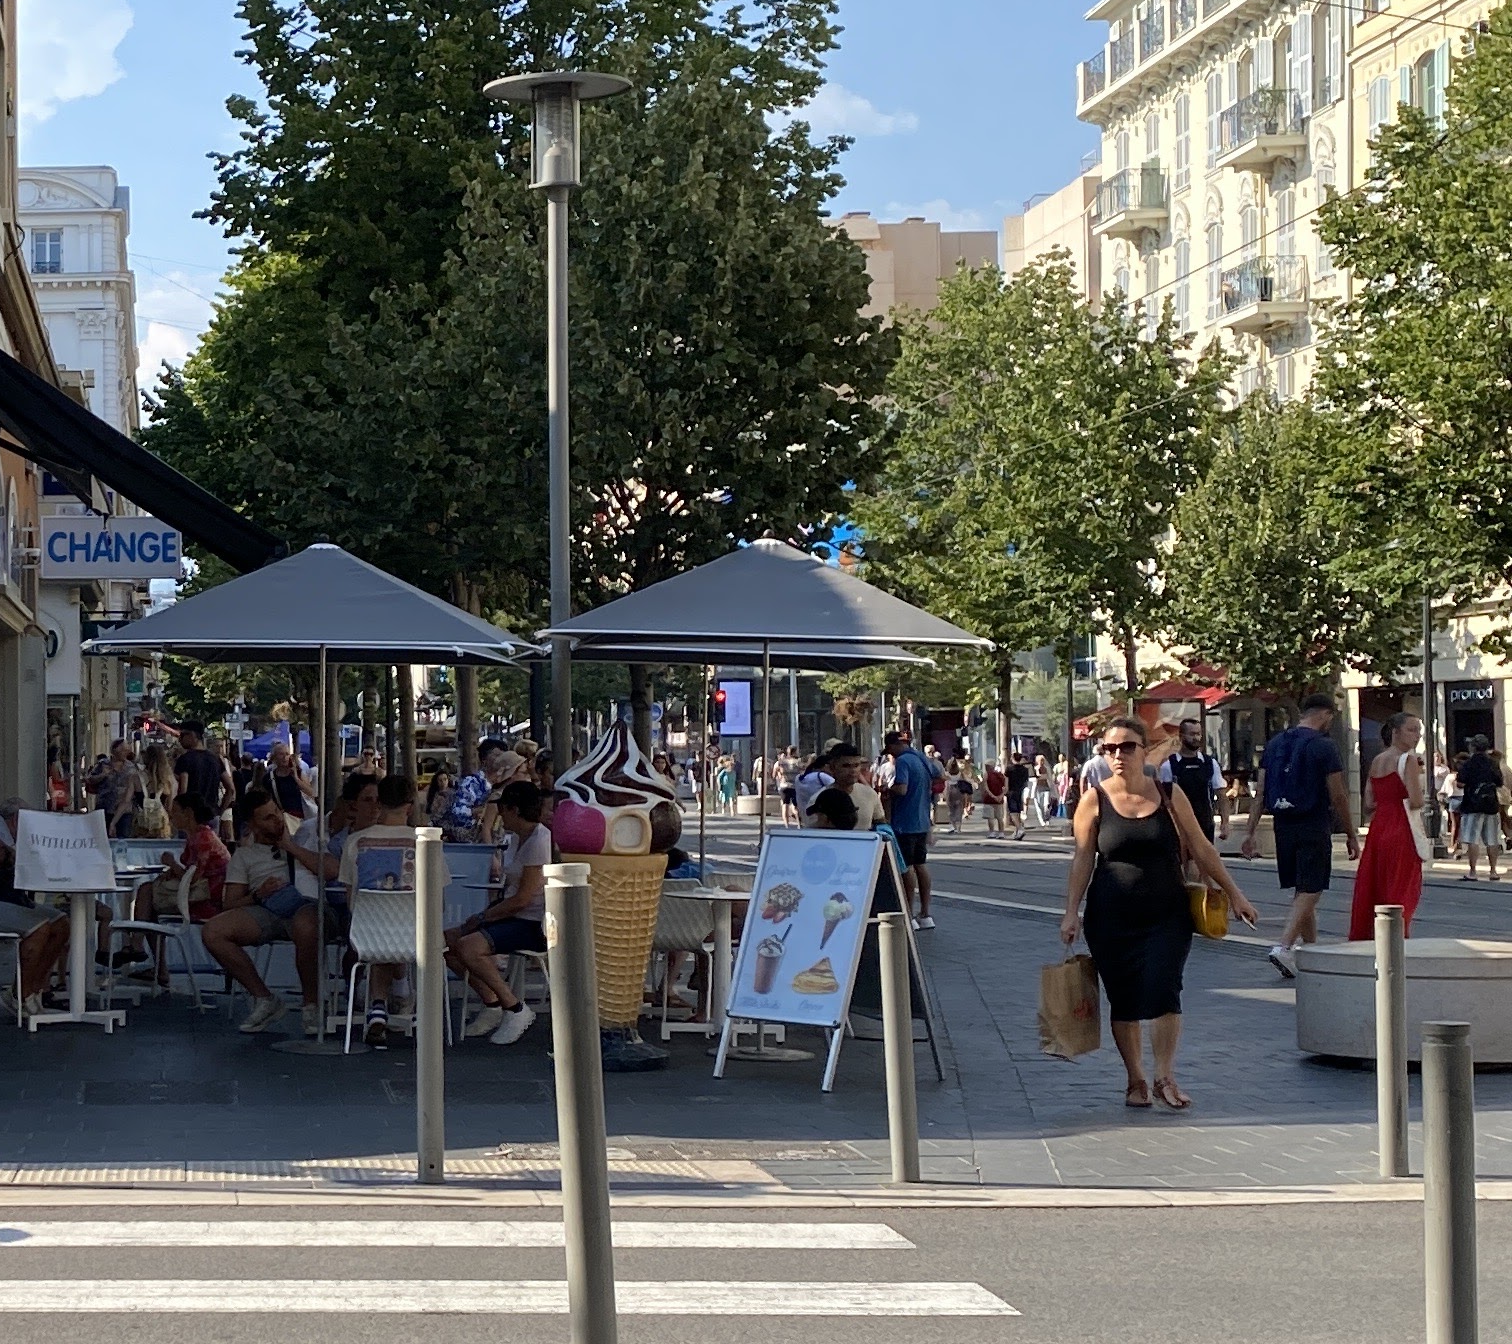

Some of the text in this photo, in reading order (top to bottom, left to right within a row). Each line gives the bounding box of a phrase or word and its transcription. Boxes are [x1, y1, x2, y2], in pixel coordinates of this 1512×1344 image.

[47, 531, 177, 563] CHANGE
[1450, 685, 1493, 703] promod
[65, 837, 99, 850] LOVE
